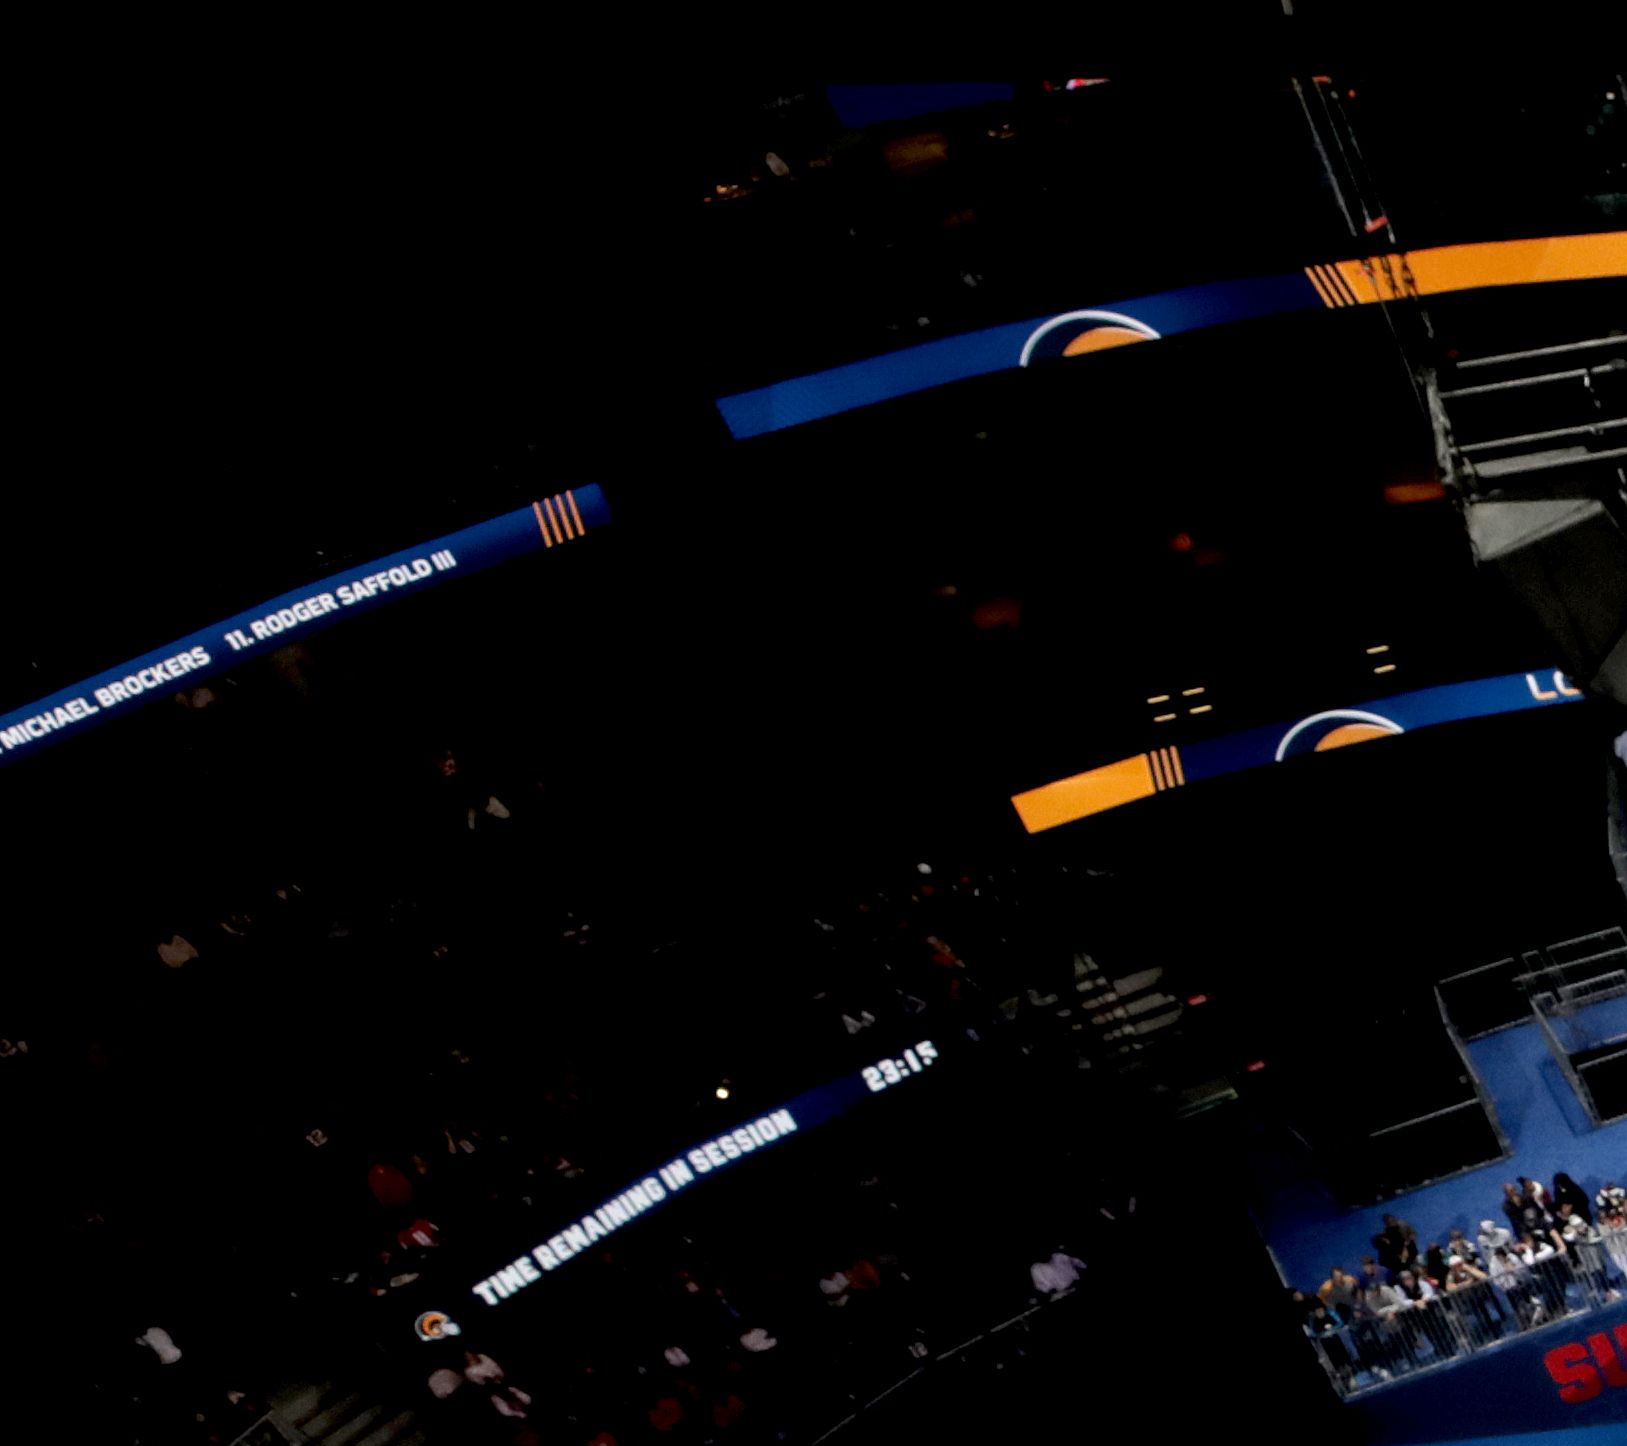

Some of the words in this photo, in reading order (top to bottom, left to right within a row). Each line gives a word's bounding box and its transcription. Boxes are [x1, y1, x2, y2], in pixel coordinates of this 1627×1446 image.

[0, 697, 100, 750] MICHAEL
[94, 645, 212, 710] BROCKERS
[223, 629, 255, 652] 11.
[250, 592, 338, 641] RODGER
[335, 558, 433, 606] SAFFOLD
[431, 548, 457, 573] III
[472, 1254, 542, 1306] TIME
[531, 1175, 667, 1271] REMAINING
[658, 1157, 695, 1192] IN
[686, 1108, 798, 1174] SESSION
